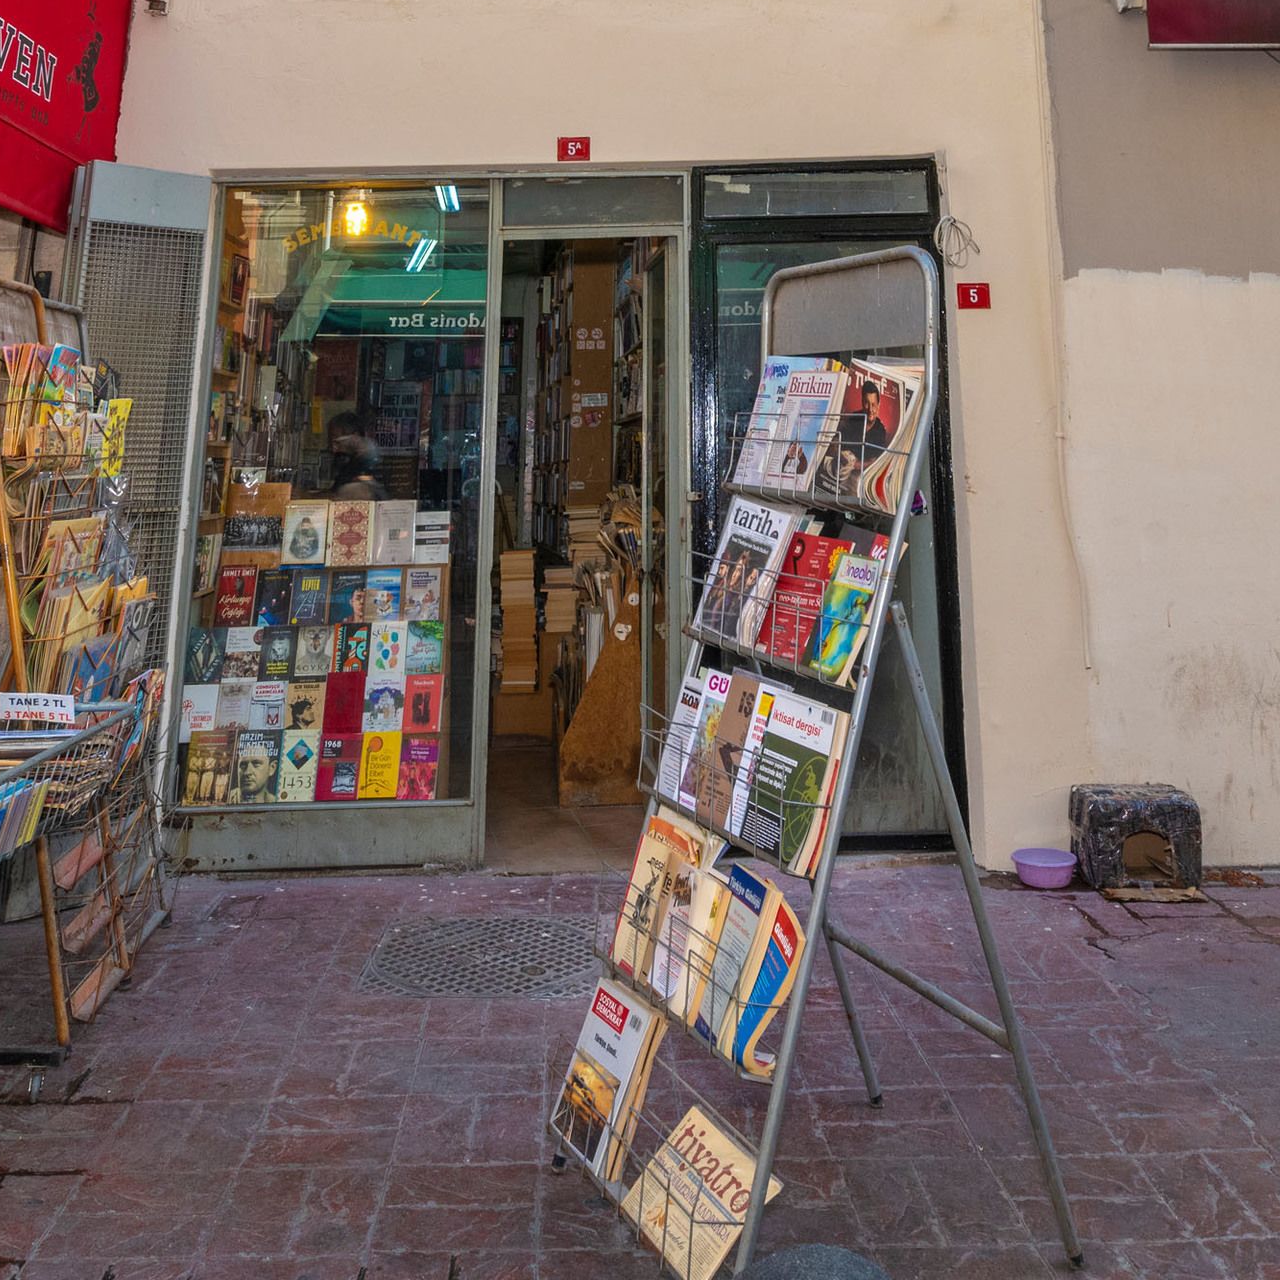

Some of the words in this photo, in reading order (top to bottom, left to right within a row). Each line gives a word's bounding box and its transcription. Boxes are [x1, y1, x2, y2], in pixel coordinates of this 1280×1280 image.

[281, 220, 424, 254] SEMEANT
[969, 288, 979, 304] 5
[789, 375, 833, 395] Birikim
[733, 504, 774, 537] tarih
[8, 697, 40, 707] TANE
[41, 698, 50, 707] 2
[53, 699, 67, 709] TL
[3, 711, 11, 720] 3
[14, 710, 45, 721] TANE
[48, 711, 56, 721] 5
[58, 712, 71, 722] TL
[773, 707, 795, 729] iktisat
[795, 718, 823, 738] dergisi
[239, 732, 264, 741] NAZIM
[323, 740, 343, 748] 1968
[281, 775, 313, 790] 1453
[598, 992, 617, 1013] SOSYAL
[595, 1000, 624, 1028] DEMOKRAT
[673, 1123, 751, 1214] tiyatro
